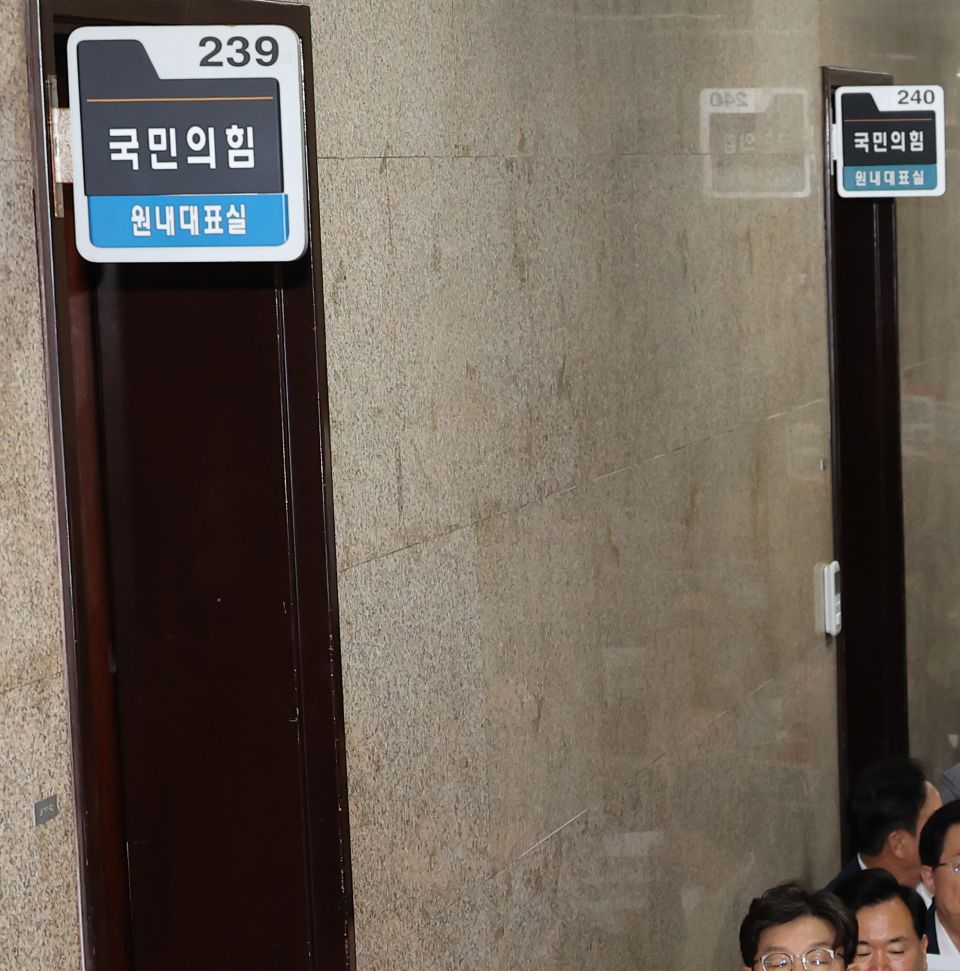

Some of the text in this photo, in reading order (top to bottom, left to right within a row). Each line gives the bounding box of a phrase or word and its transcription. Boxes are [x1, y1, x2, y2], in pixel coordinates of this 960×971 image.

[199, 36, 279, 67] 239
[897, 89, 935, 105] 240
[108, 125, 255, 171] 국민의힘
[854, 130, 925, 154] 국민의힘
[854, 169, 925, 188] 원내대표실
[130, 204, 247, 237] 원내대표실
